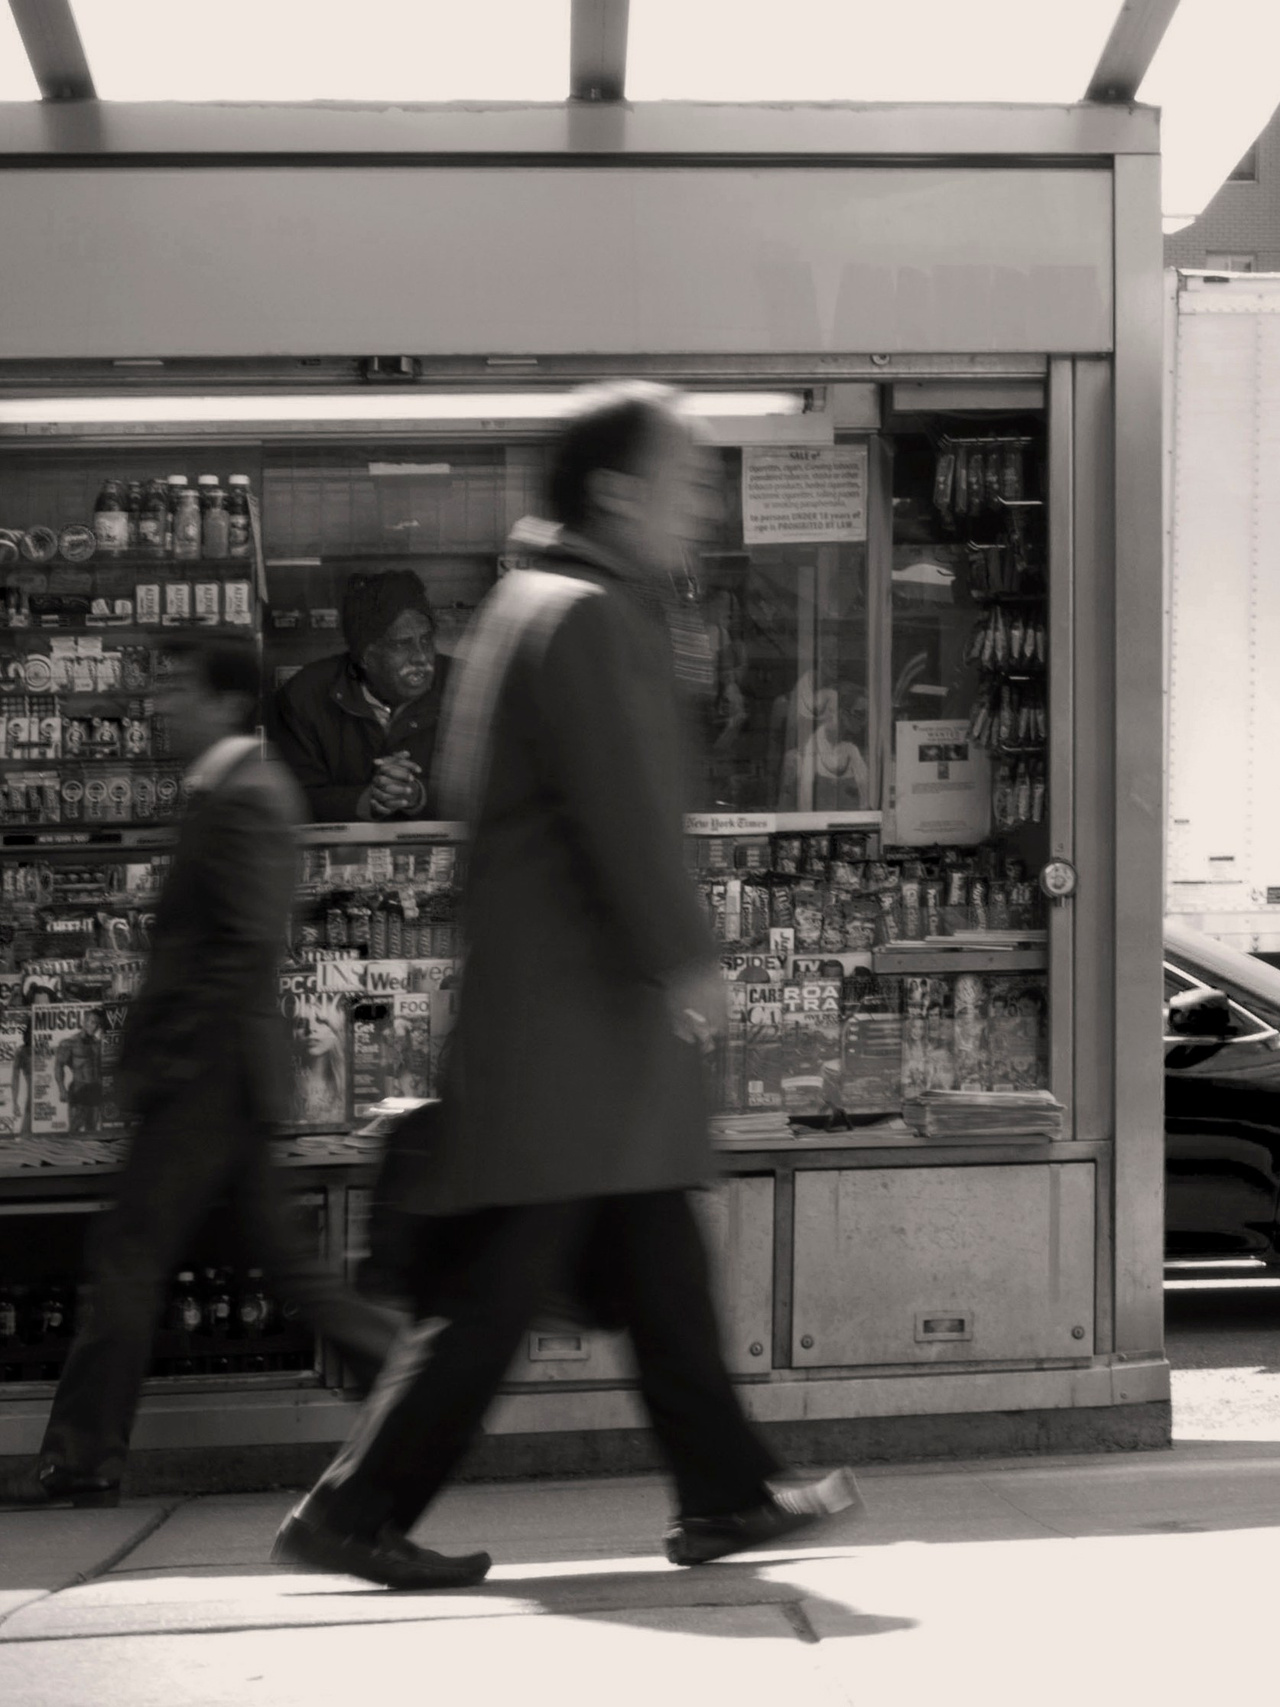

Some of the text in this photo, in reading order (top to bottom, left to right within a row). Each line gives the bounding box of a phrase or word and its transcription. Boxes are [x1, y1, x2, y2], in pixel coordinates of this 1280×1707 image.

[791, 512, 817, 521] UNDER
[711, 816, 734, 831] York
[737, 816, 768, 828] Times
[720, 955, 788, 971] SPIDEY
[796, 960, 821, 972] TV
[784, 986, 840, 999] ROA
[400, 1001, 429, 1013] FOO
[784, 998, 840, 1012] TRA
[34, 1010, 83, 1031] MUSCL
